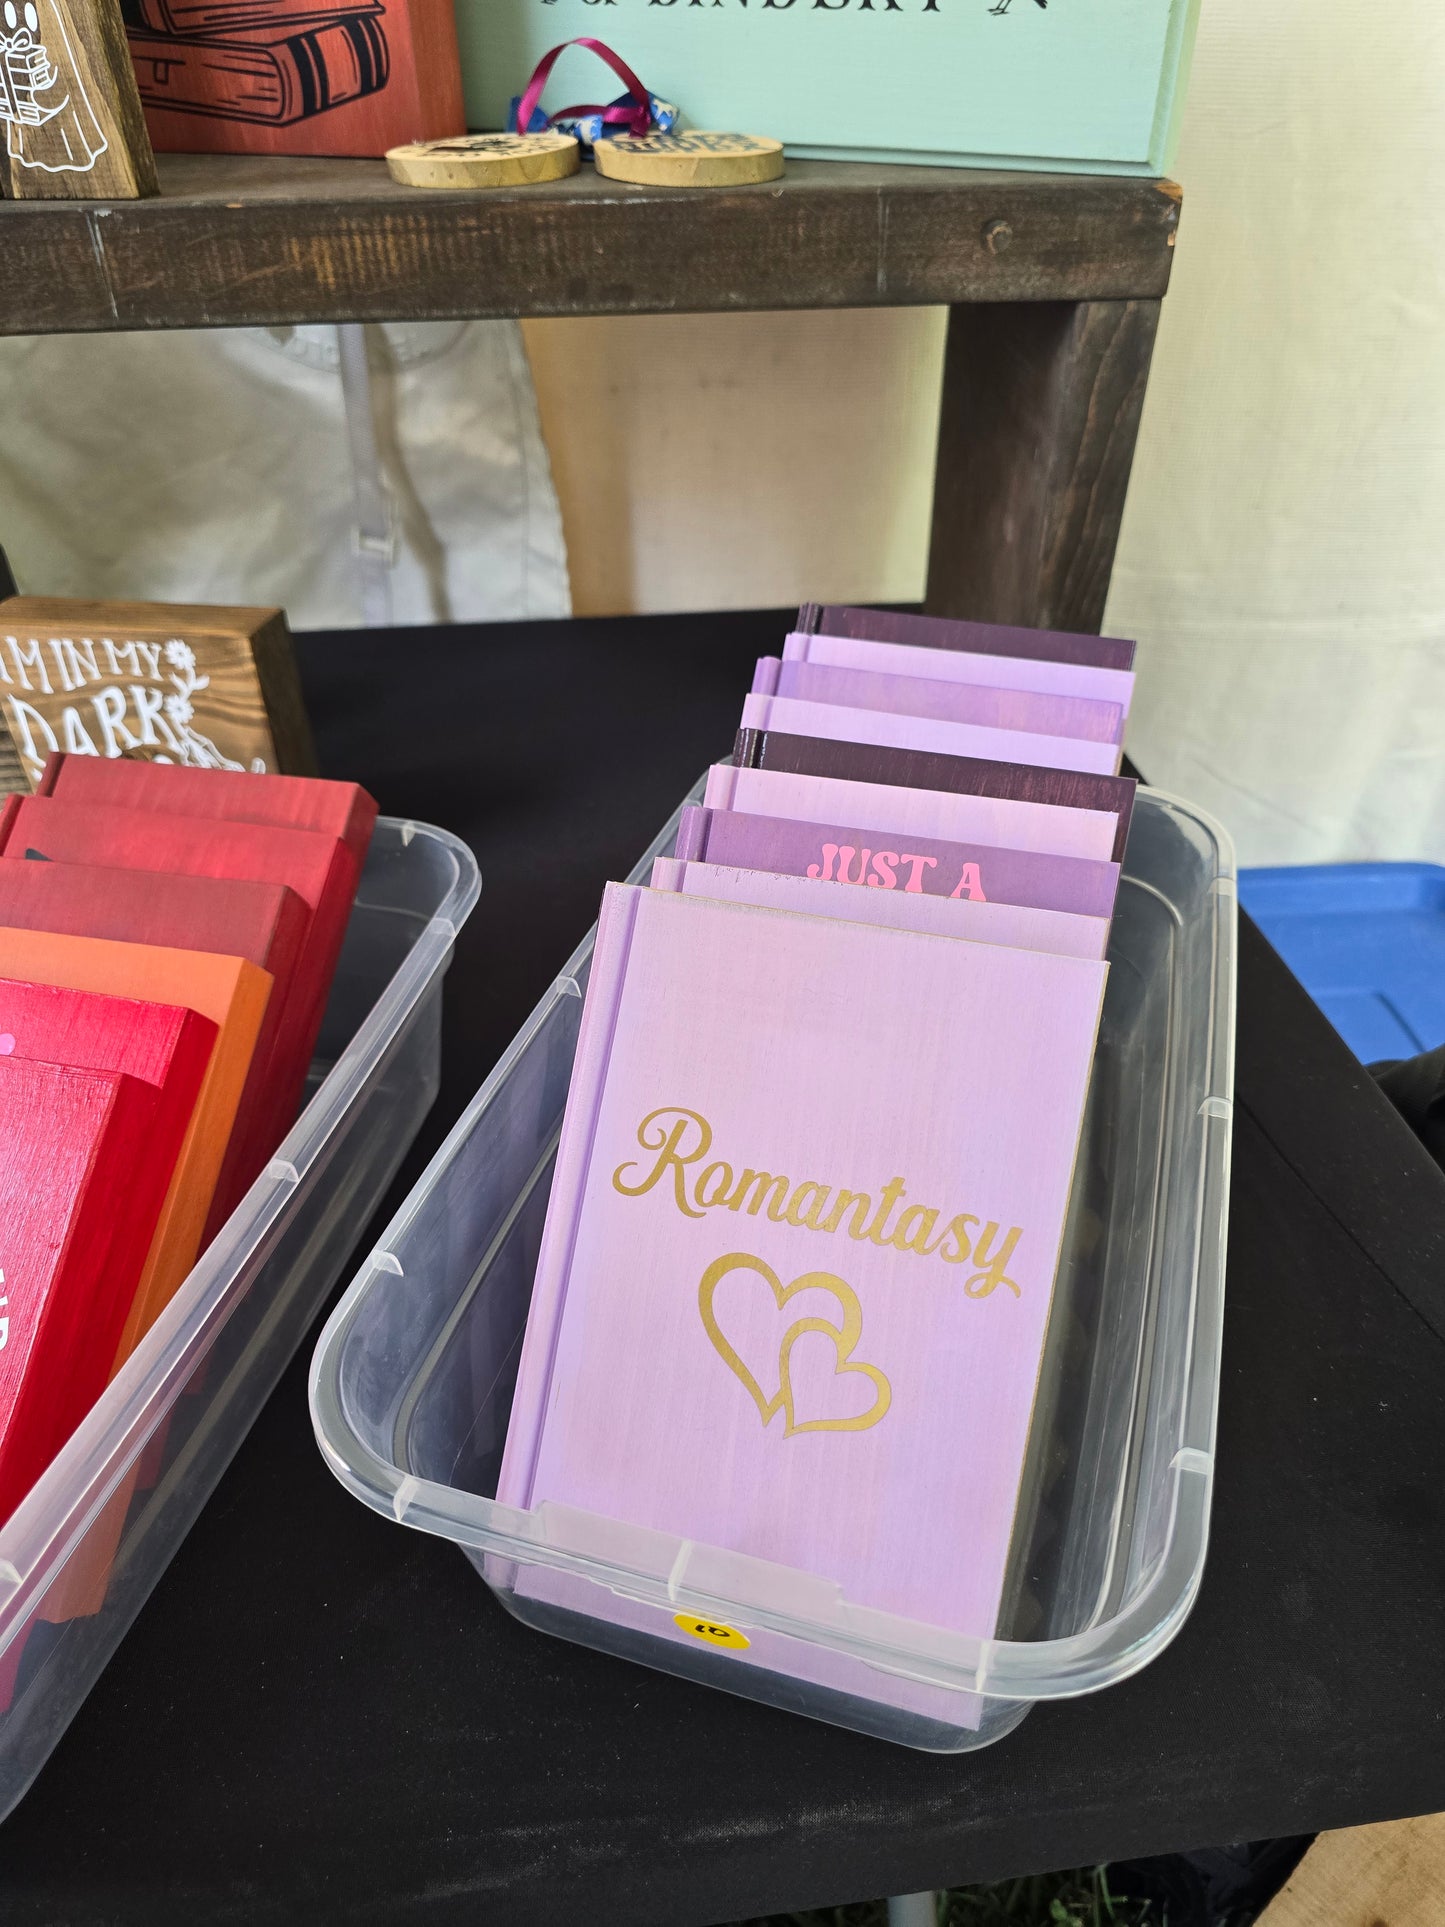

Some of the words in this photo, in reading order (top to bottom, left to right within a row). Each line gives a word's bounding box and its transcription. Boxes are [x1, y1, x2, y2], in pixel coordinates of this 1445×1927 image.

[48, 638, 102, 691] IN
[102, 638, 164, 681] MY
[8, 684, 186, 767] DARK
[806, 843, 938, 893] JUST
[950, 862, 986, 902] A
[612, 1106, 1023, 1299] Romantasy
